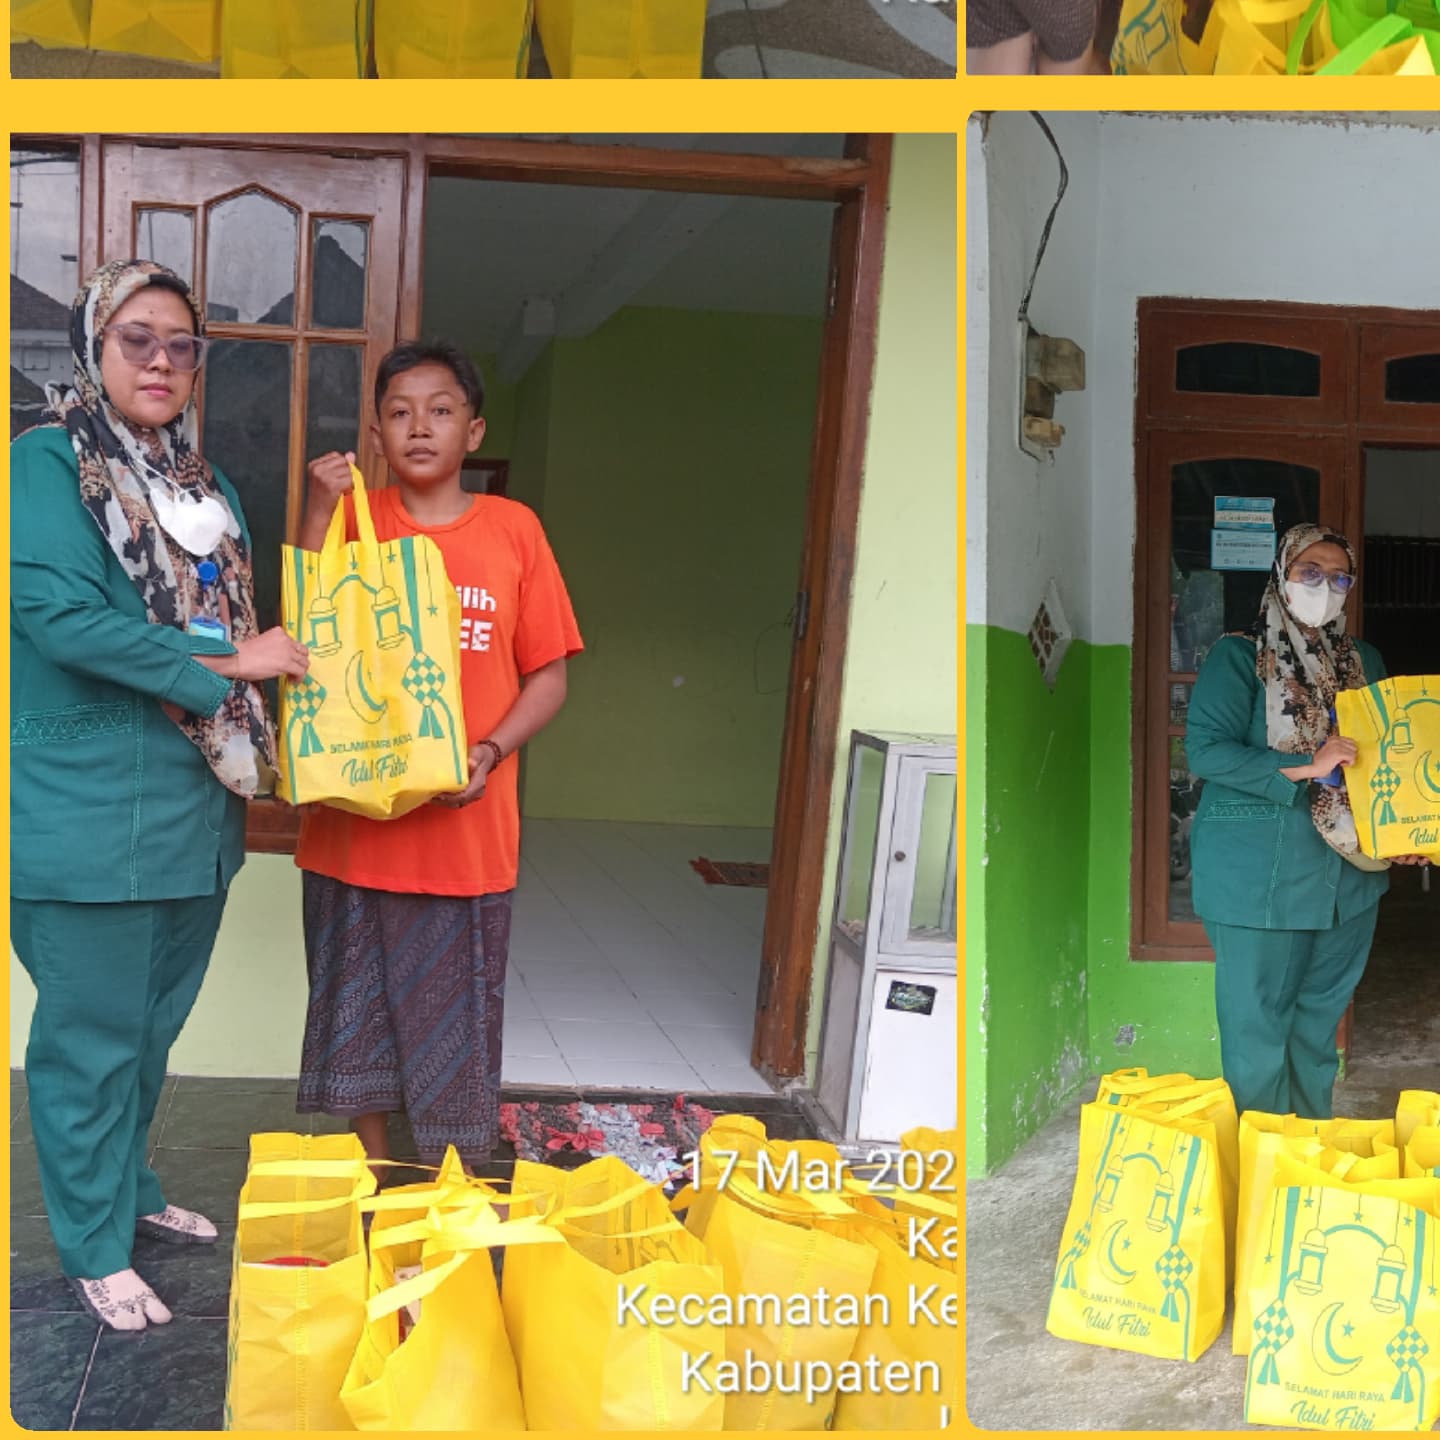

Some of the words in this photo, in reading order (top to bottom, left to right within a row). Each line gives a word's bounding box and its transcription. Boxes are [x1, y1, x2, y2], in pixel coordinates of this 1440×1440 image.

[1408, 826, 1438, 848] Idul
[1082, 1306, 1114, 1331] Idul
[1118, 1314, 1151, 1337] Fitri
[1285, 1381, 1330, 1399] SELAMAT
[1332, 1390, 1357, 1401] HARI
[1359, 1391, 1385, 1402] RAYA
[1290, 1400, 1331, 1426] Idul
[1335, 1406, 1376, 1431] Fitri
